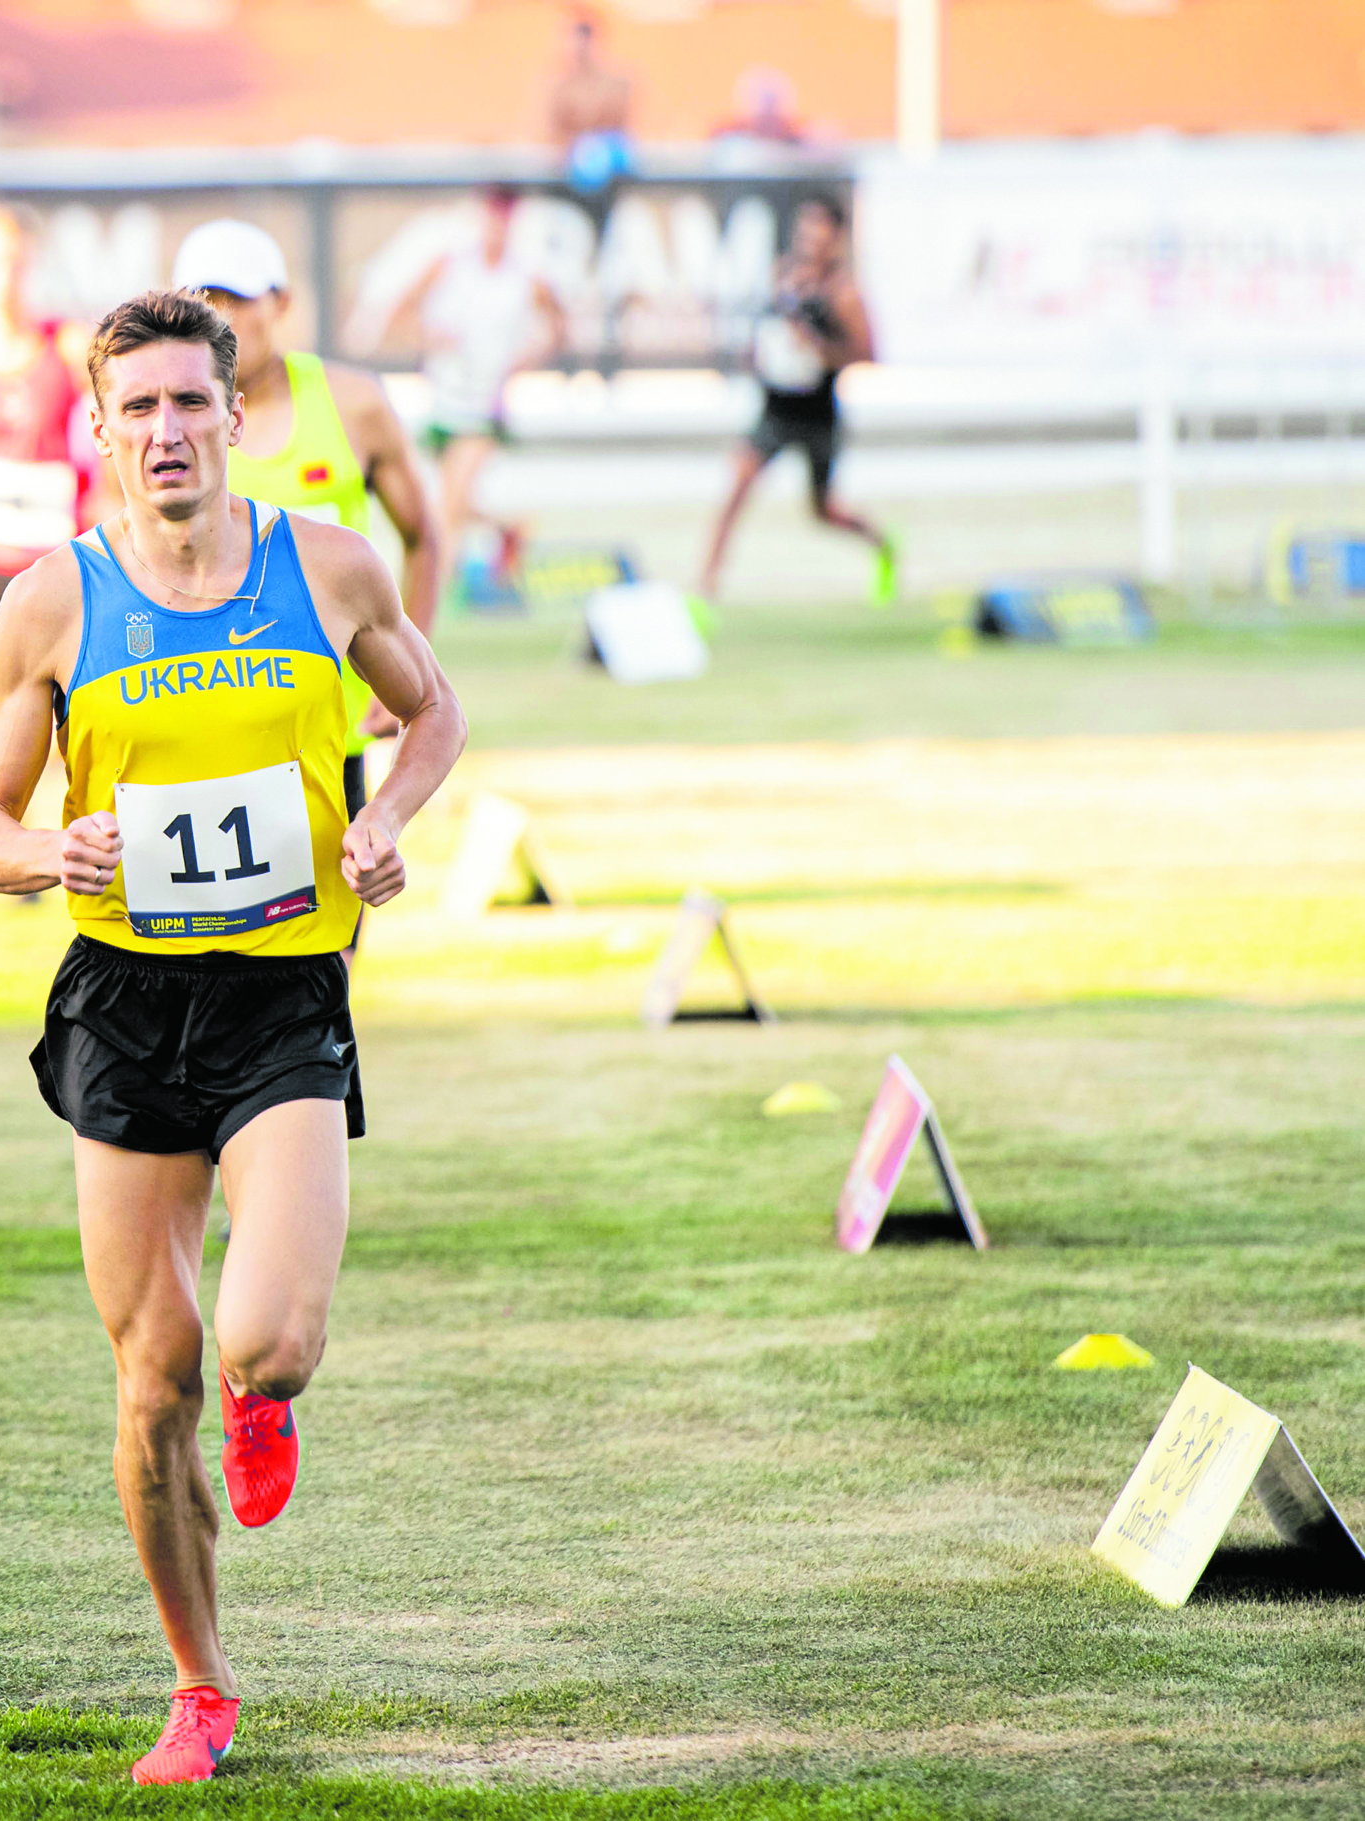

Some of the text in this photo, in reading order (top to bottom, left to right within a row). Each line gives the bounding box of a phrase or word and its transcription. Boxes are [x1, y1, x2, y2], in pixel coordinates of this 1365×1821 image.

[120, 656, 296, 706] UKRAINE
[163, 804, 271, 885] 11
[150, 917, 185, 930] UIPM
[209, 918, 247, 927] Championships
